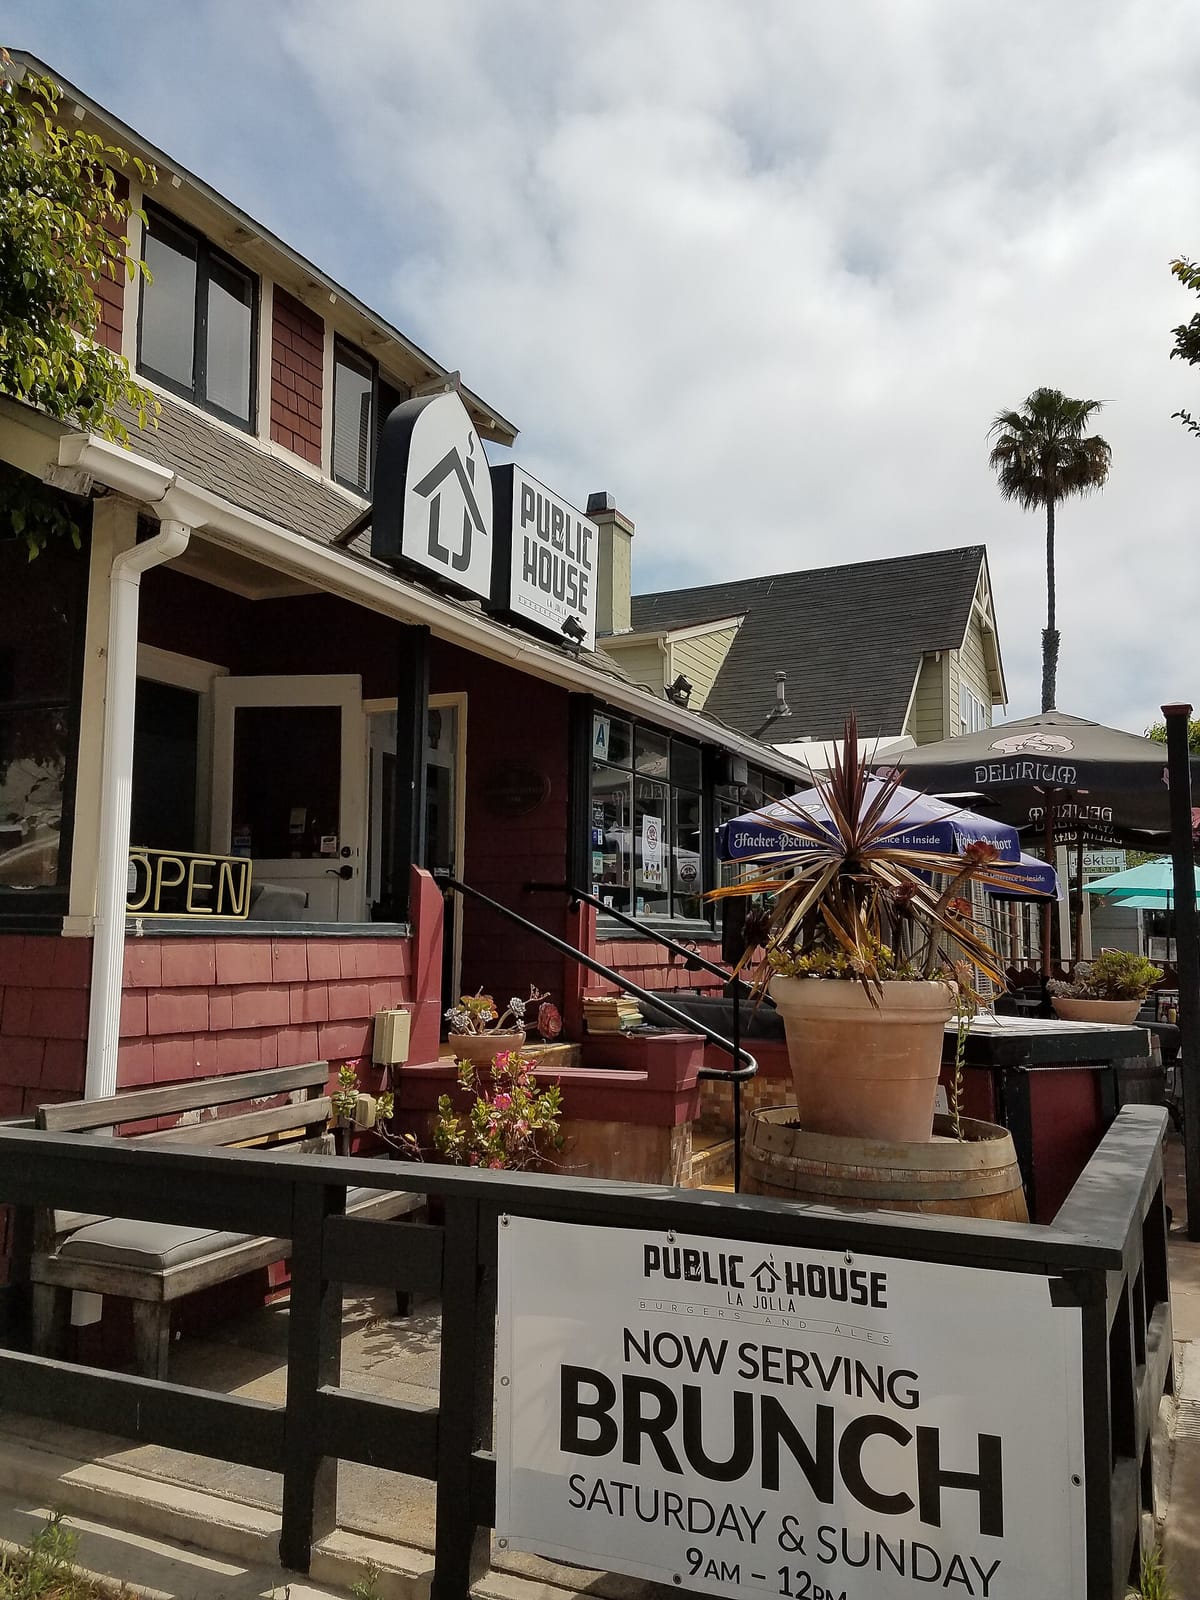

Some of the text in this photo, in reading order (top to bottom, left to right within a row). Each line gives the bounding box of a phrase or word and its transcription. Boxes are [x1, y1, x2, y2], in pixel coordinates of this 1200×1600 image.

[521, 482, 592, 571] PUBLIC
[523, 535, 588, 616] HOUSE
[595, 723, 605, 747] A
[975, 761, 1077, 784] DELIRIUM
[902, 836, 910, 844] Is
[912, 835, 940, 844] Inside
[126, 854, 246, 914] OPEN
[643, 1244, 745, 1289] PUBLIC
[784, 1261, 888, 1309] HOUSE
[727, 1291, 796, 1313] LA JOLLA
[640, 1301, 890, 1344] BURGERS AND ALES
[623, 1327, 920, 1410] NOW SERVING
[559, 1363, 1004, 1538] BRUNCH
[568, 1473, 1002, 1598] SATURDAY & SUNDAY
[685, 1547, 741, 1585] 9AM
